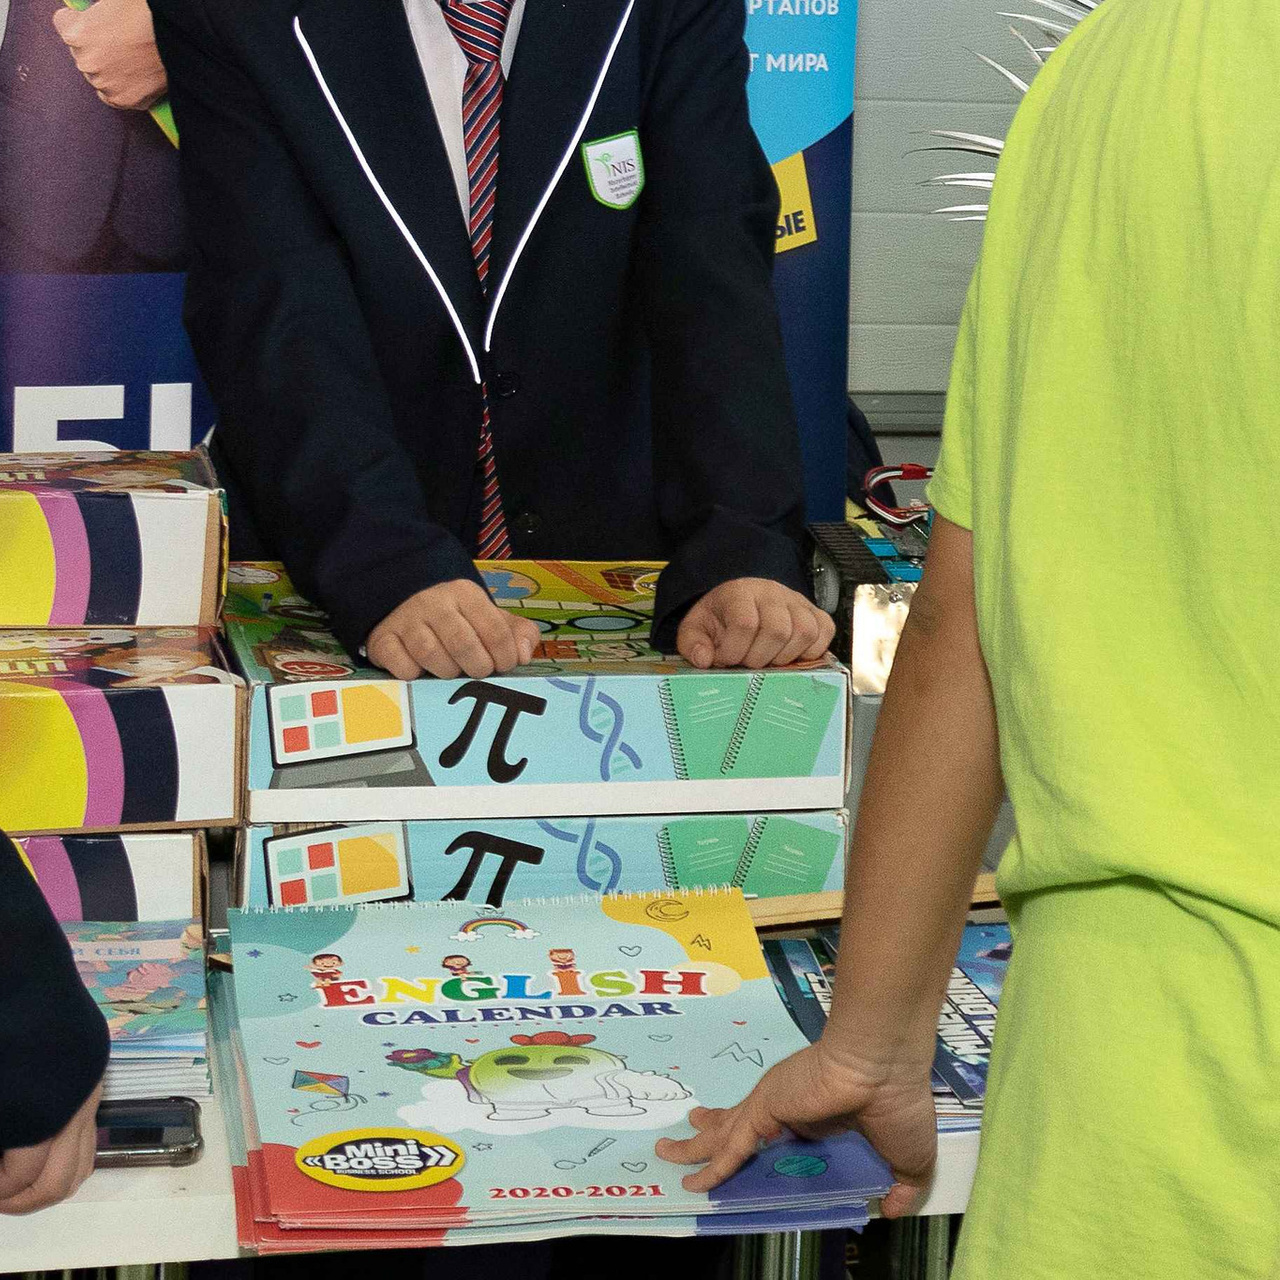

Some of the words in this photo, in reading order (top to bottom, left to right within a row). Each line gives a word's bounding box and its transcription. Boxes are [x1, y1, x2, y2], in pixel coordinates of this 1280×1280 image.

[766, 53, 829, 72] МИРА
[611, 158, 636, 177] NIS
[321, 970, 709, 1008] ENGLISH
[362, 1001, 684, 1026] CALENDAR
[345, 1139, 420, 1158] Mini
[489, 1184, 666, 1199] 2020-2021
